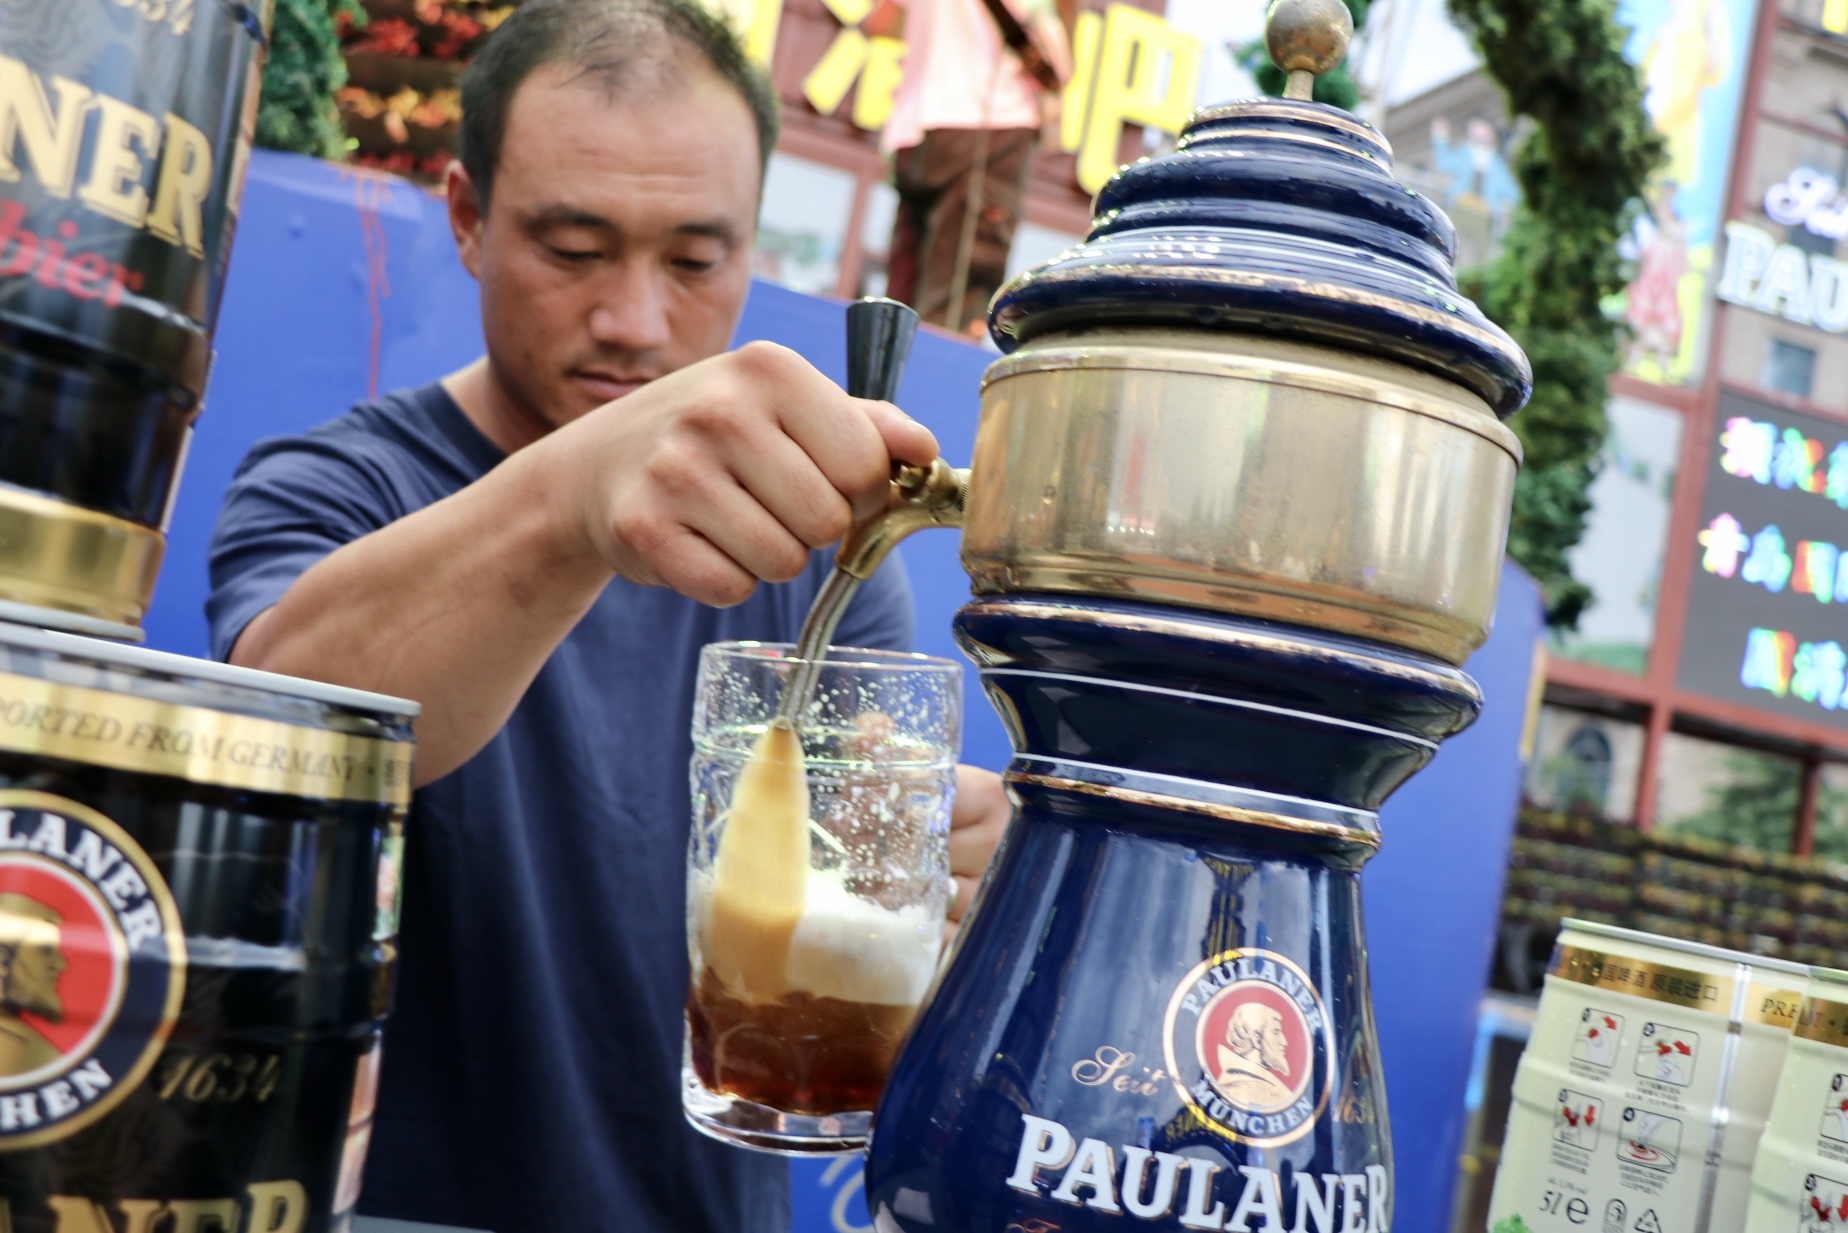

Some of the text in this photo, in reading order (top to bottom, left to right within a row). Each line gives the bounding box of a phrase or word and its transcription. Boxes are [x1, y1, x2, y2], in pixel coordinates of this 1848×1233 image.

[126, 719, 224, 761] FROM
[1180, 958, 1322, 1035] PAULANER
[159, 1053, 281, 1104] 1634
[1071, 1044, 1166, 1096] Seit
[1190, 1074, 1315, 1135] MÜNCHEN
[1006, 1113, 1389, 1233] PAULANER
